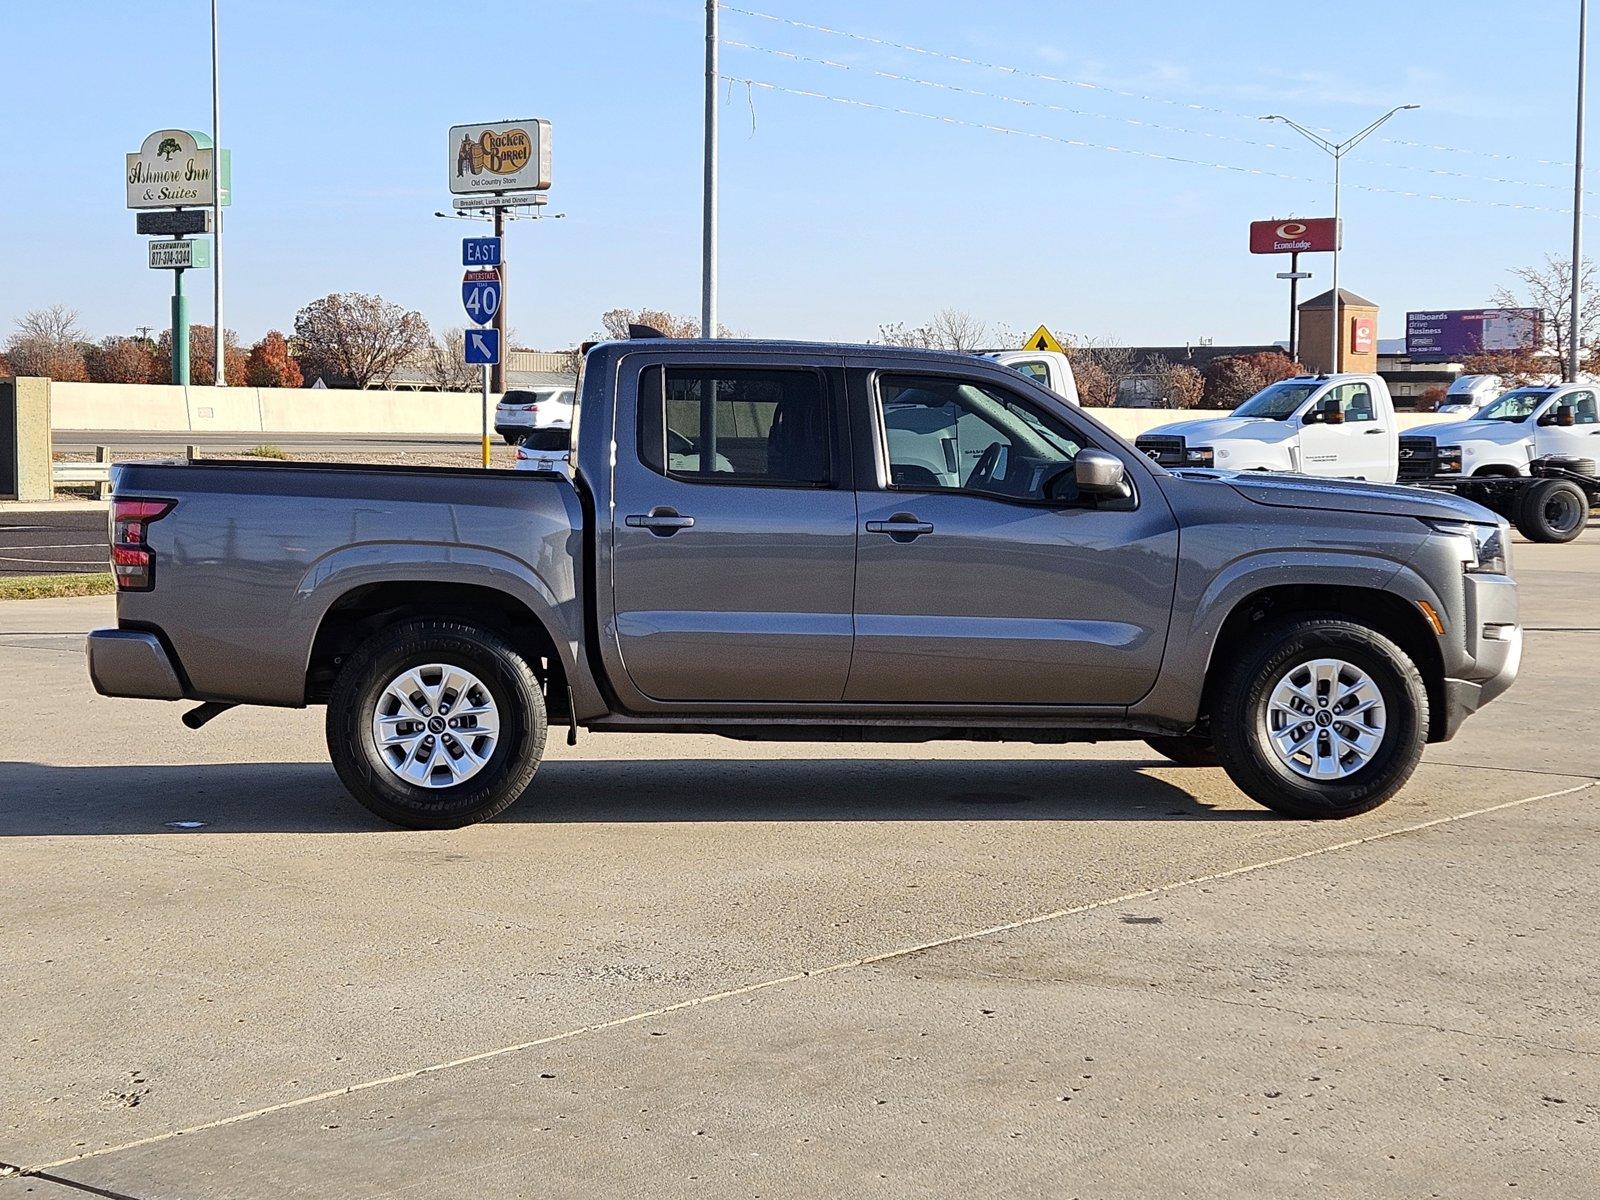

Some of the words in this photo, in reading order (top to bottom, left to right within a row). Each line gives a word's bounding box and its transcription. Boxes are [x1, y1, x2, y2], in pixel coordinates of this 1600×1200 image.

[480, 132, 524, 154] Cracker
[489, 147, 527, 171] Barrel
[129, 162, 180, 184] Ashmore
[185, 159, 210, 181] Inn
[143, 189, 154, 200] &
[158, 187, 197, 200] Suites
[151, 241, 190, 250] RESERVATION
[467, 243, 495, 261] EAST
[151, 251, 190, 265] 877-374-3344
[466, 287, 496, 315] 40
